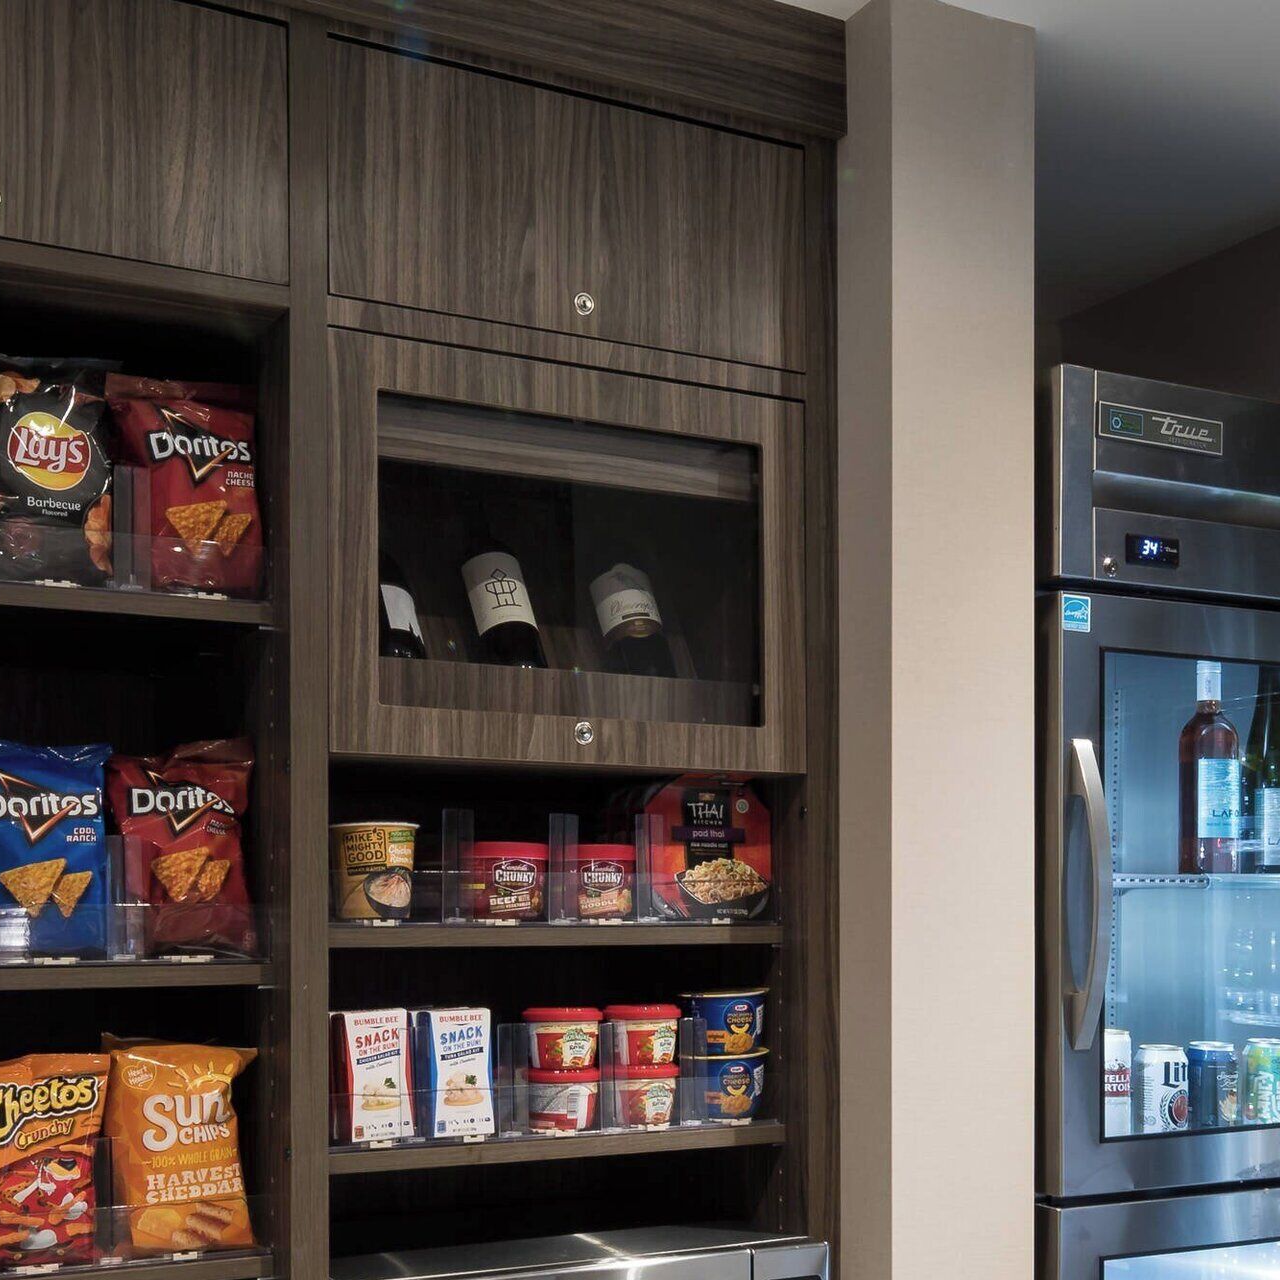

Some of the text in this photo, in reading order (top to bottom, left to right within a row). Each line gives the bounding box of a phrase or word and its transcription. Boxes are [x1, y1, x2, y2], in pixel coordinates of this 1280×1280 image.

[15, 427, 85, 473] Lay's
[149, 431, 251, 463] Doritos
[27, 496, 81, 512] Barbecue
[1142, 540, 1158, 555] 34
[132, 787, 235, 815] Doritos
[687, 802, 725, 819] THAI
[66, 834, 98, 843] RANCH
[73, 826, 96, 835] COOL
[346, 831, 384, 843] MIKE'S
[347, 842, 383, 852] MIGHTY
[348, 850, 383, 863] GOOD
[495, 869, 534, 884] CHUNKY
[583, 872, 623, 886] CHUNKY
[490, 896, 519, 906] BEEF
[353, 1015, 400, 1026] BUMBLE BEE
[439, 1014, 484, 1024] BUMBLE BEE
[355, 1028, 400, 1049] SNACK
[440, 1026, 483, 1046] SNACK
[1104, 1073, 1131, 1084] TELLA
[1161, 1061, 1189, 1088] Lit
[142, 1089, 232, 1152] Sun
[14, 1117, 74, 1150] Crunchy
[178, 1122, 231, 1146] CHIPS
[151, 1151, 208, 1169] 100% WHOLE
[147, 1162, 242, 1190] HARVEST
[145, 1176, 244, 1204] CHEDDAR
